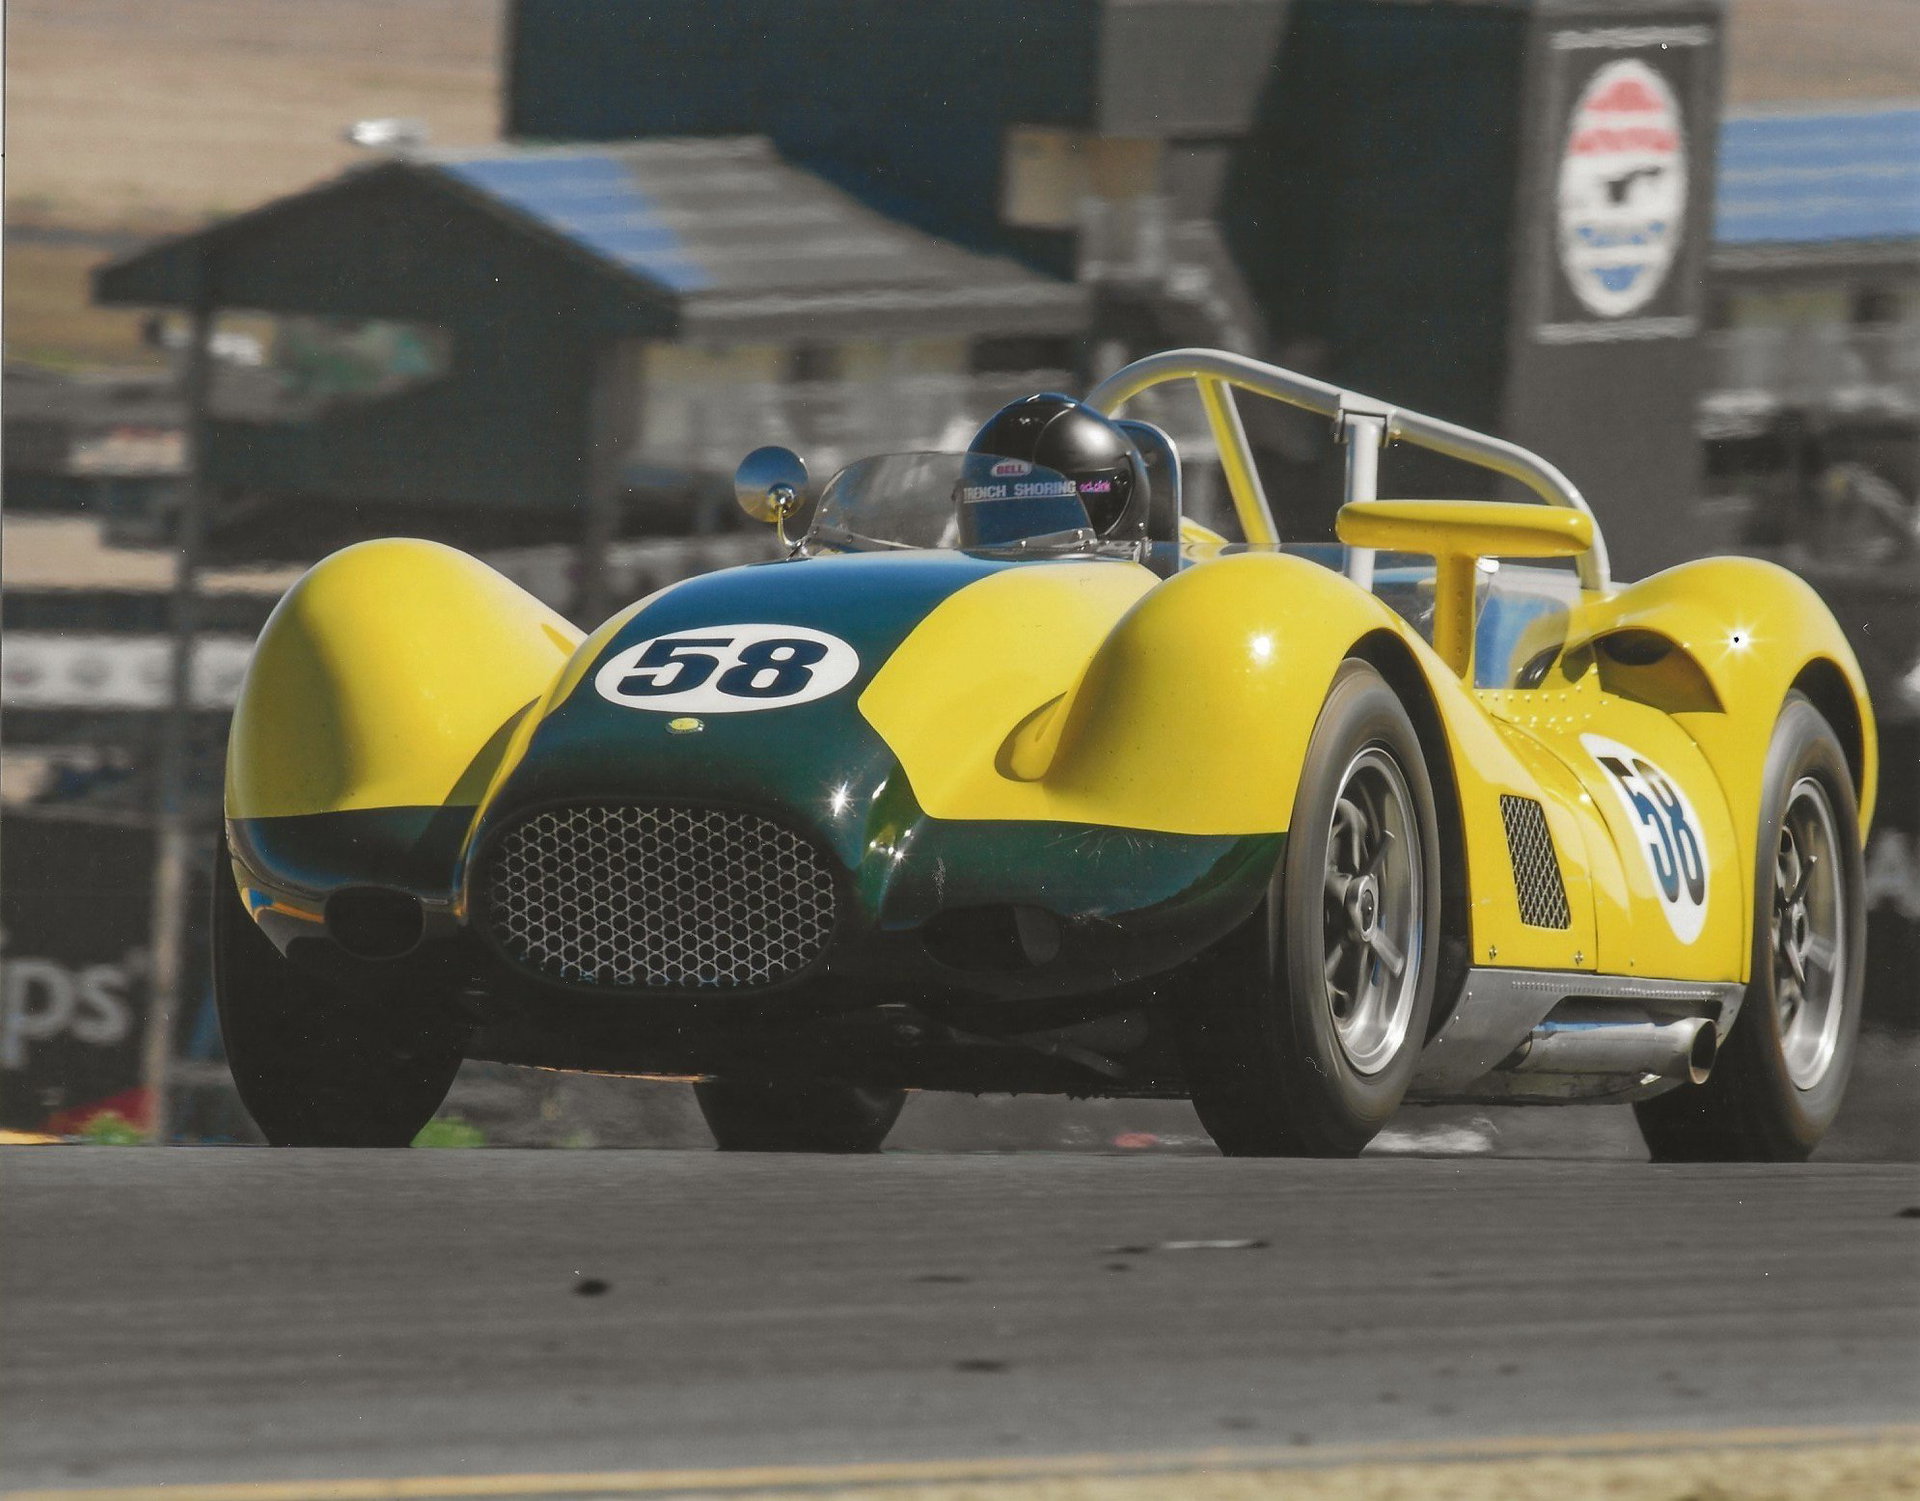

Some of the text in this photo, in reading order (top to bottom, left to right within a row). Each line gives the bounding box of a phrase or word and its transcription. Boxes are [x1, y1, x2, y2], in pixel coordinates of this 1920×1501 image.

[996, 463, 1025, 475] BELL
[1013, 480, 1077, 497] SHORING
[616, 637, 829, 699] 58
[1596, 756, 1705, 906] 58
